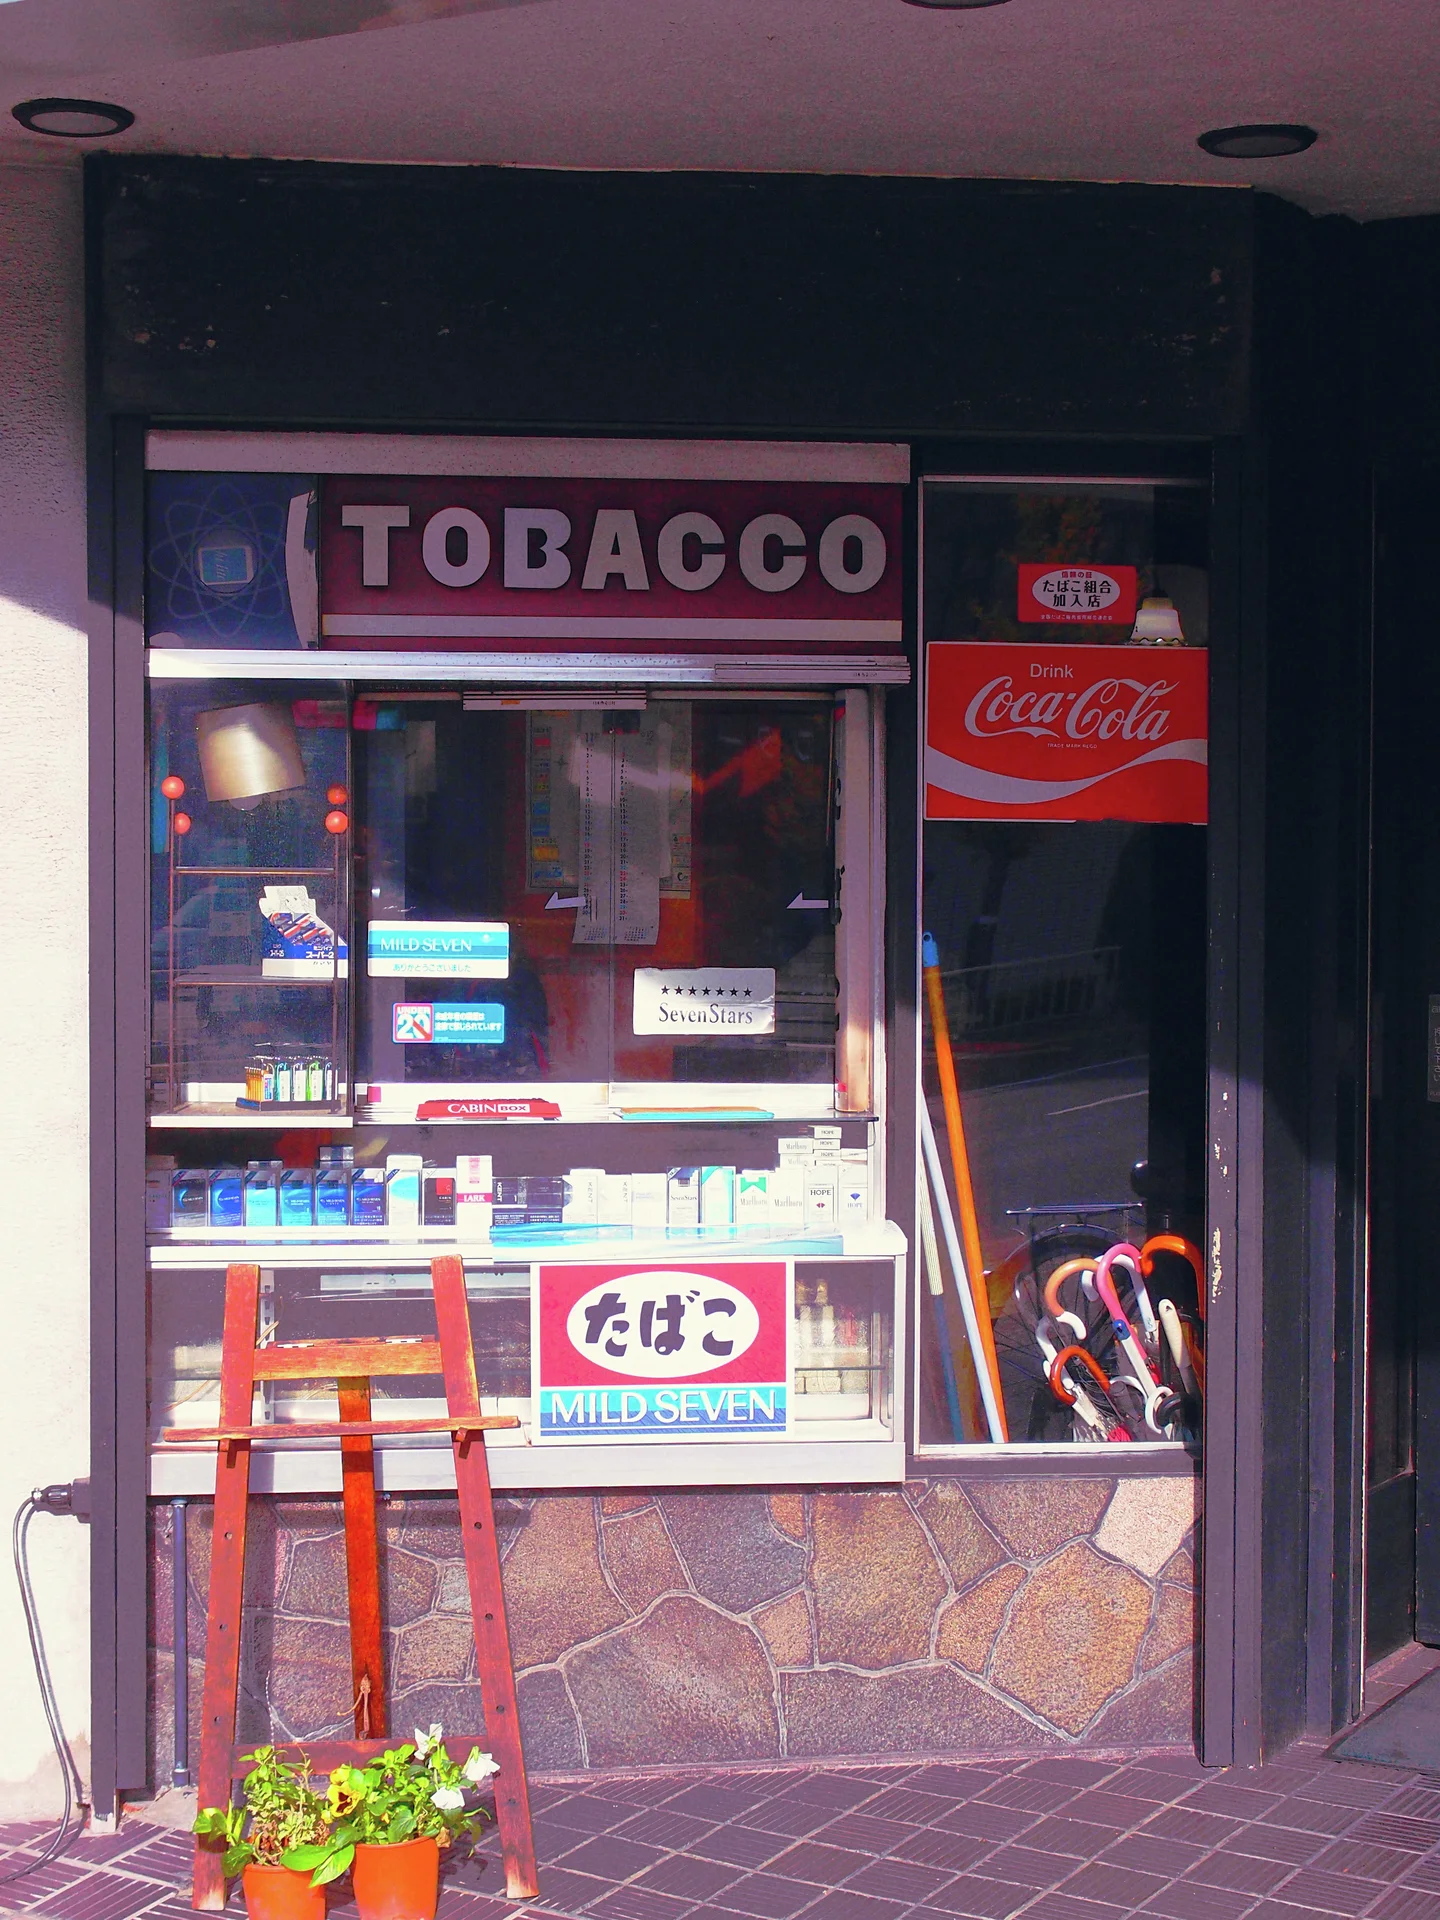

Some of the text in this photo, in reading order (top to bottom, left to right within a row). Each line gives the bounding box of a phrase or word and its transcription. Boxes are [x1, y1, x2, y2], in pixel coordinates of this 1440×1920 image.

[342, 504, 887, 593] TOBACCO
[1042, 580, 1112, 594] たばこ組合
[1052, 593, 1101, 608] 加入店
[1030, 663, 1074, 679] Drink
[964, 675, 1180, 741] Coca-Cola
[380, 937, 473, 952] MILD SEVEN
[447, 1103, 495, 1113] CABIN
[463, 1194, 486, 1202] LARK
[774, 1195, 802, 1207] Marlboro
[584, 1290, 737, 1357] たばこ
[552, 1388, 776, 1424] MILD SEVEN
